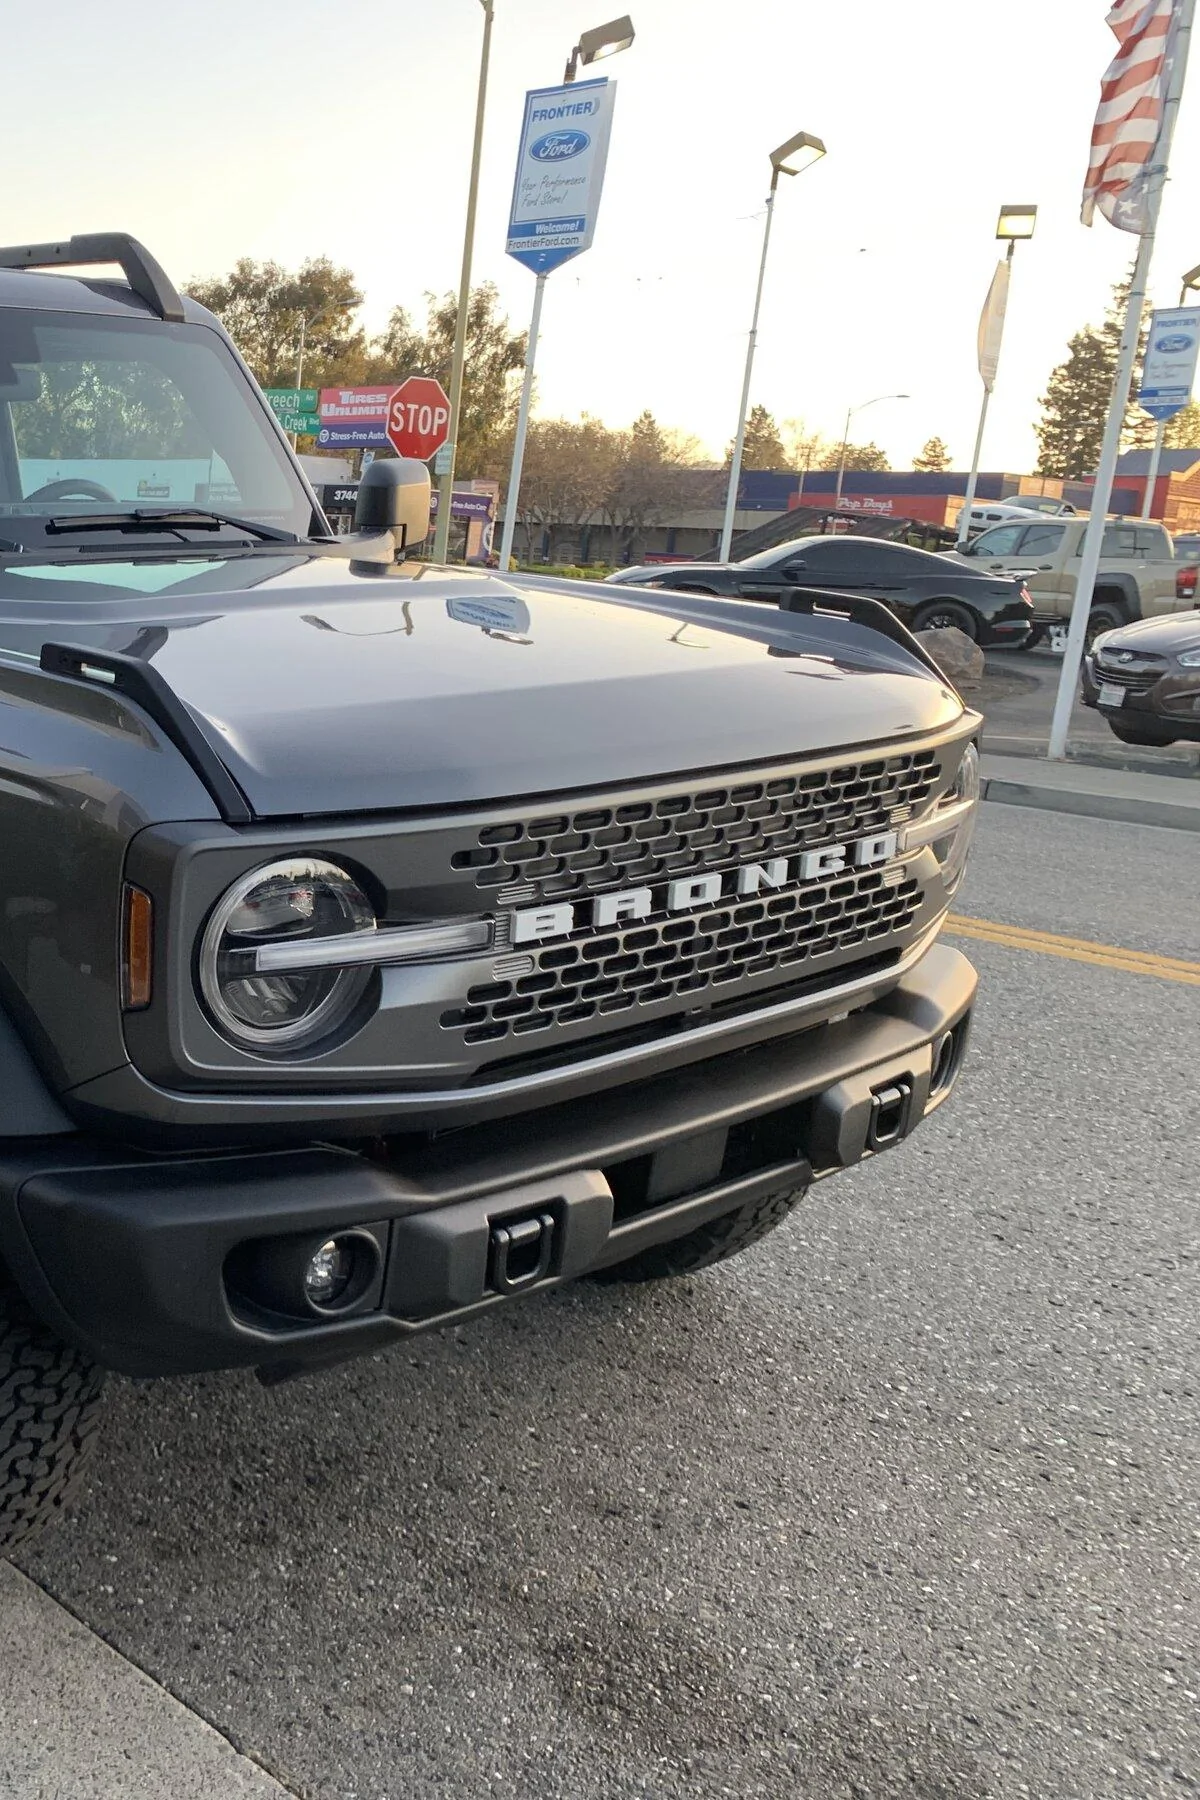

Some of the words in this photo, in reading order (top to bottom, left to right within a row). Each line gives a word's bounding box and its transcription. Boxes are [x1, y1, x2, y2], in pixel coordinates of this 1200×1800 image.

[532, 101, 592, 122] FRONTIER
[539, 134, 579, 158] Ford
[535, 220, 580, 235] Welcome!
[508, 236, 580, 249] FrontierFord.com
[284, 414, 308, 431] Creek
[390, 402, 448, 436] STOP
[330, 431, 367, 441] Stress-Free
[367, 431, 385, 441] Auto
[334, 490, 359, 501] 3744
[511, 832, 897, 944] BRONCO
